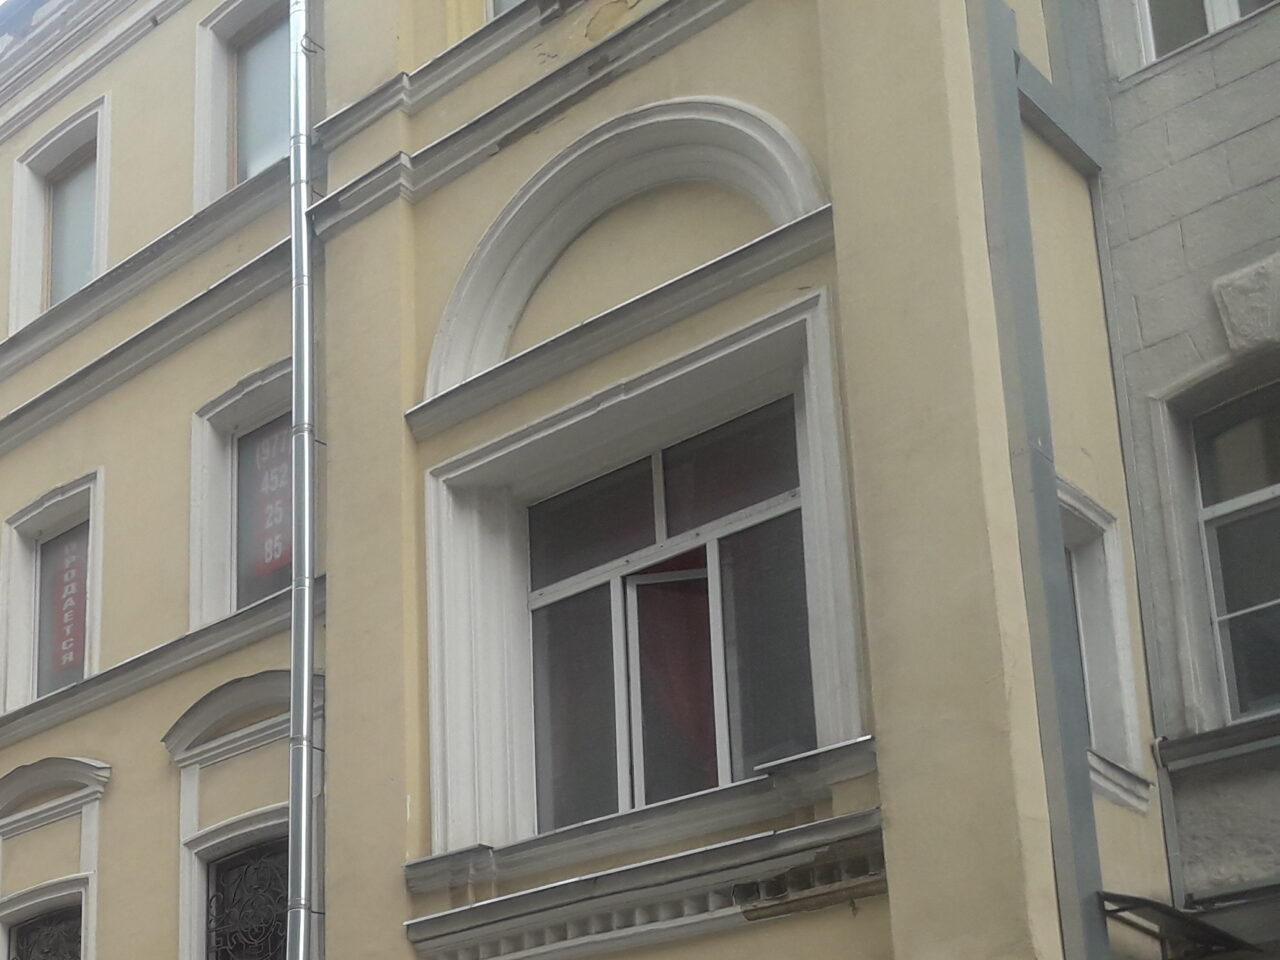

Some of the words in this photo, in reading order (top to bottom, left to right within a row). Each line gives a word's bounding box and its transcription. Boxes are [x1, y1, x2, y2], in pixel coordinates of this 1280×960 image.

[261, 463, 289, 495] 452
[264, 499, 283, 529] 25
[61, 543, 77, 665] ПРОДАЕТСЯ
